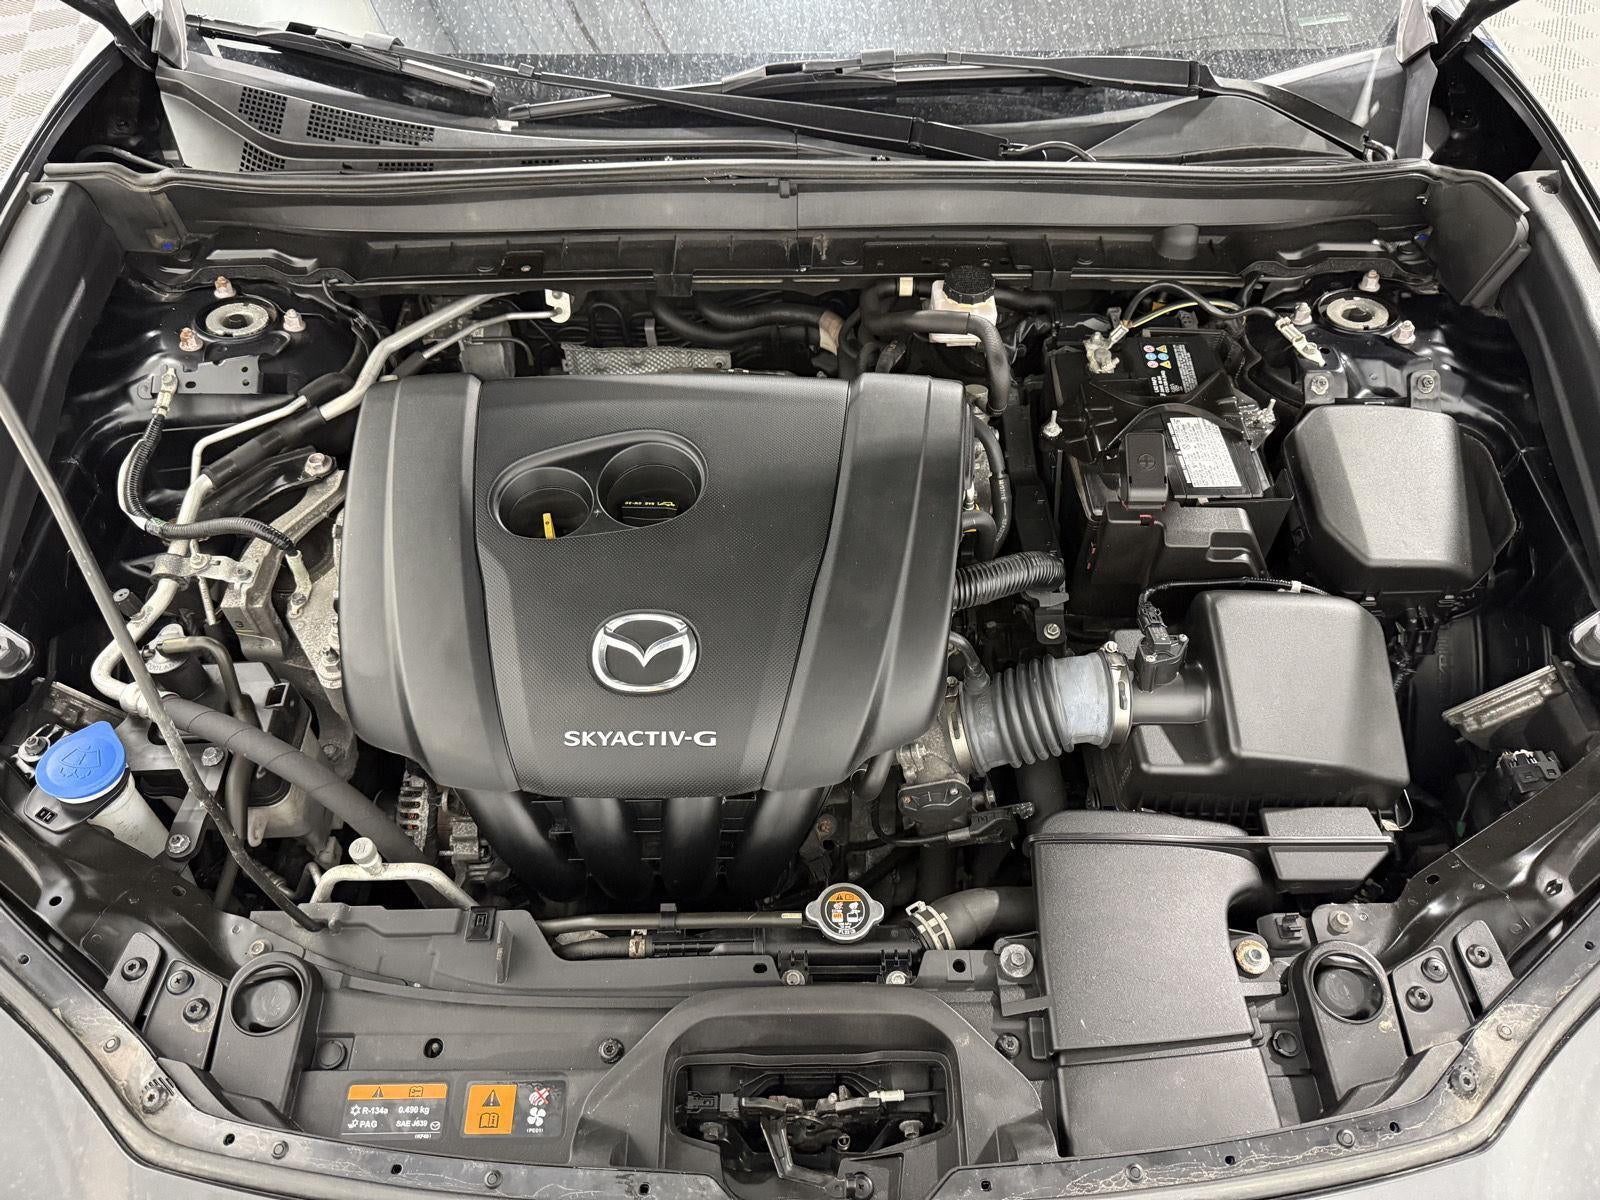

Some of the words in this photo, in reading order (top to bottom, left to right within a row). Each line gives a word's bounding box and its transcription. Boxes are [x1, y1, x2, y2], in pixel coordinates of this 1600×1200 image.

[564, 730, 717, 747] SKYACTIV-G
[362, 1106, 389, 1115] R-134a
[398, 1105, 418, 1114] 0.490
[419, 1105, 430, 1115] kg
[359, 1120, 378, 1128] PAG
[395, 1120, 411, 1128] SAE
[411, 1119, 428, 1128] J639
